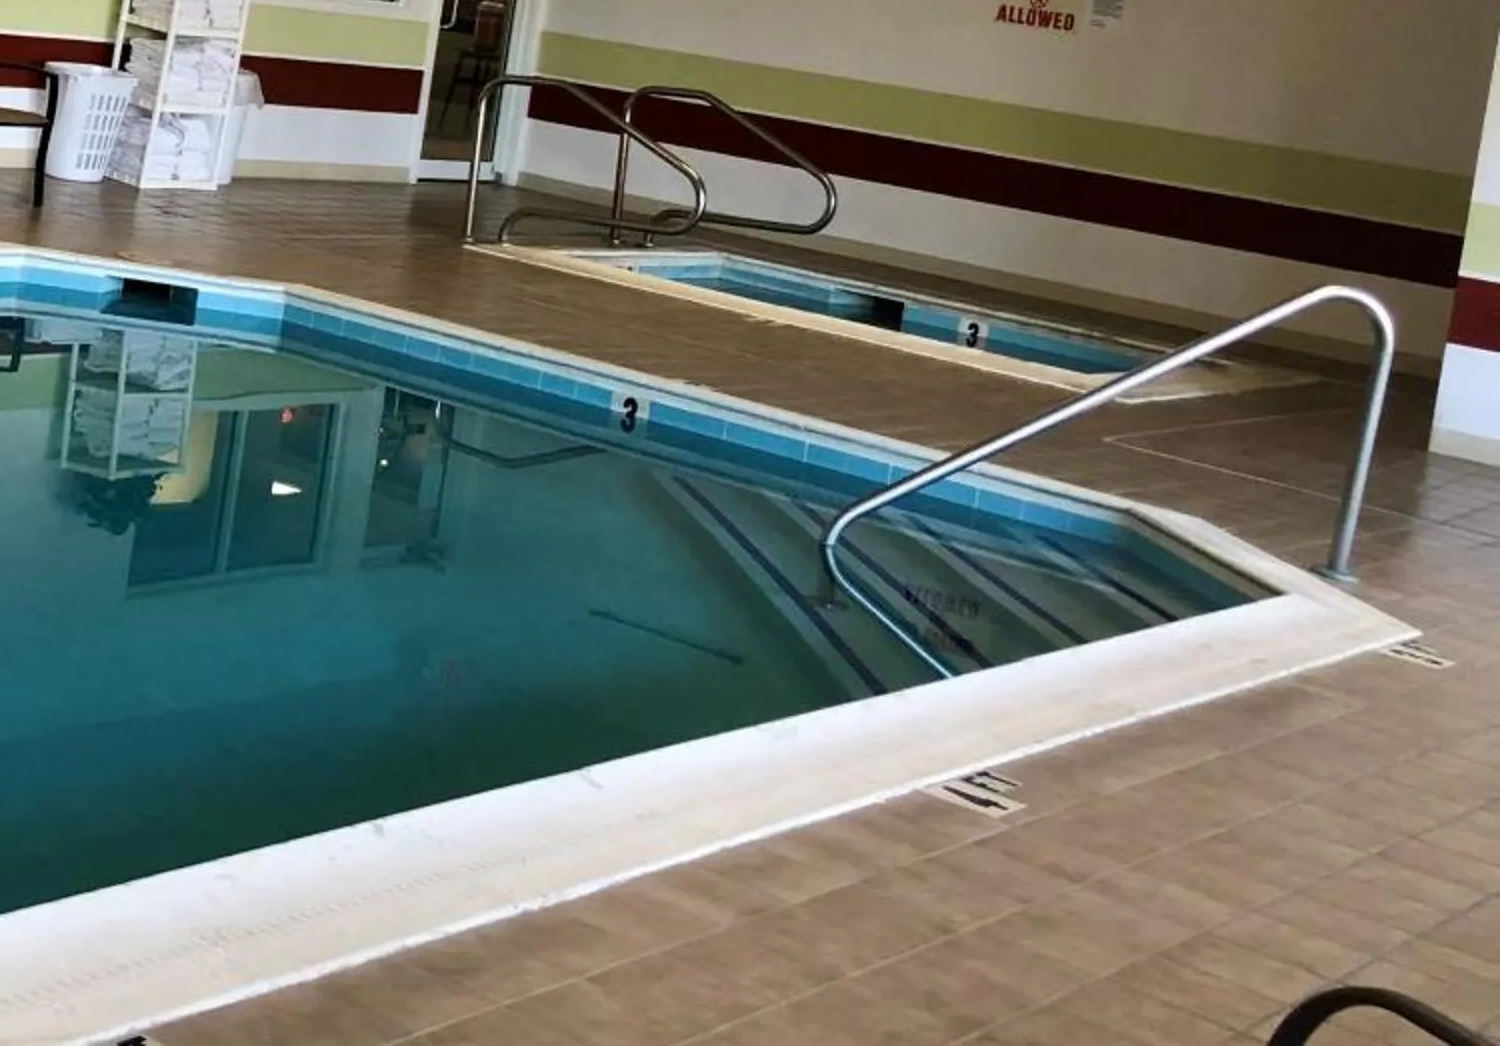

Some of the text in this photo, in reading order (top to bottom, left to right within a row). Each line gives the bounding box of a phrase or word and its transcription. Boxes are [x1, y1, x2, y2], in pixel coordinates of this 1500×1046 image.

[995, 3, 1076, 32] ALLOWED
[966, 322, 980, 348] 3
[620, 397, 639, 434] 3
